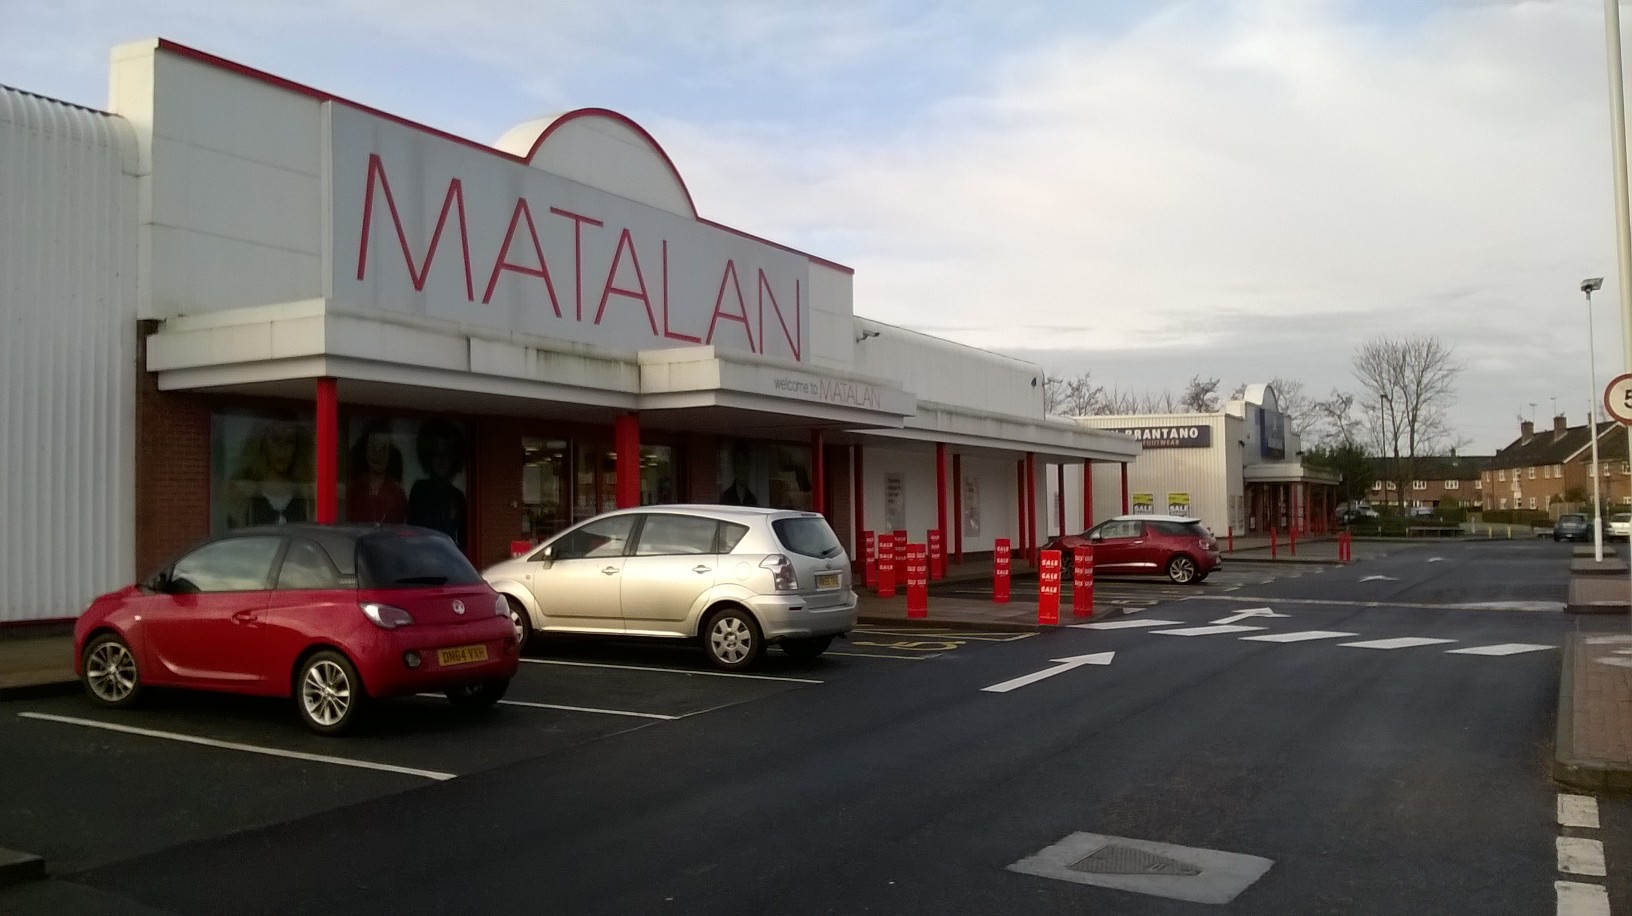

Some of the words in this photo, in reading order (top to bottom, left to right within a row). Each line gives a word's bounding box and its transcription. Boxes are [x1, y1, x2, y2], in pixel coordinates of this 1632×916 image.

[356, 153, 801, 362] MATALAN
[774, 377, 809, 394] welcome
[810, 382, 818, 396] to
[819, 379, 881, 409] MATALAN
[1041, 572, 1058, 580] SALE
